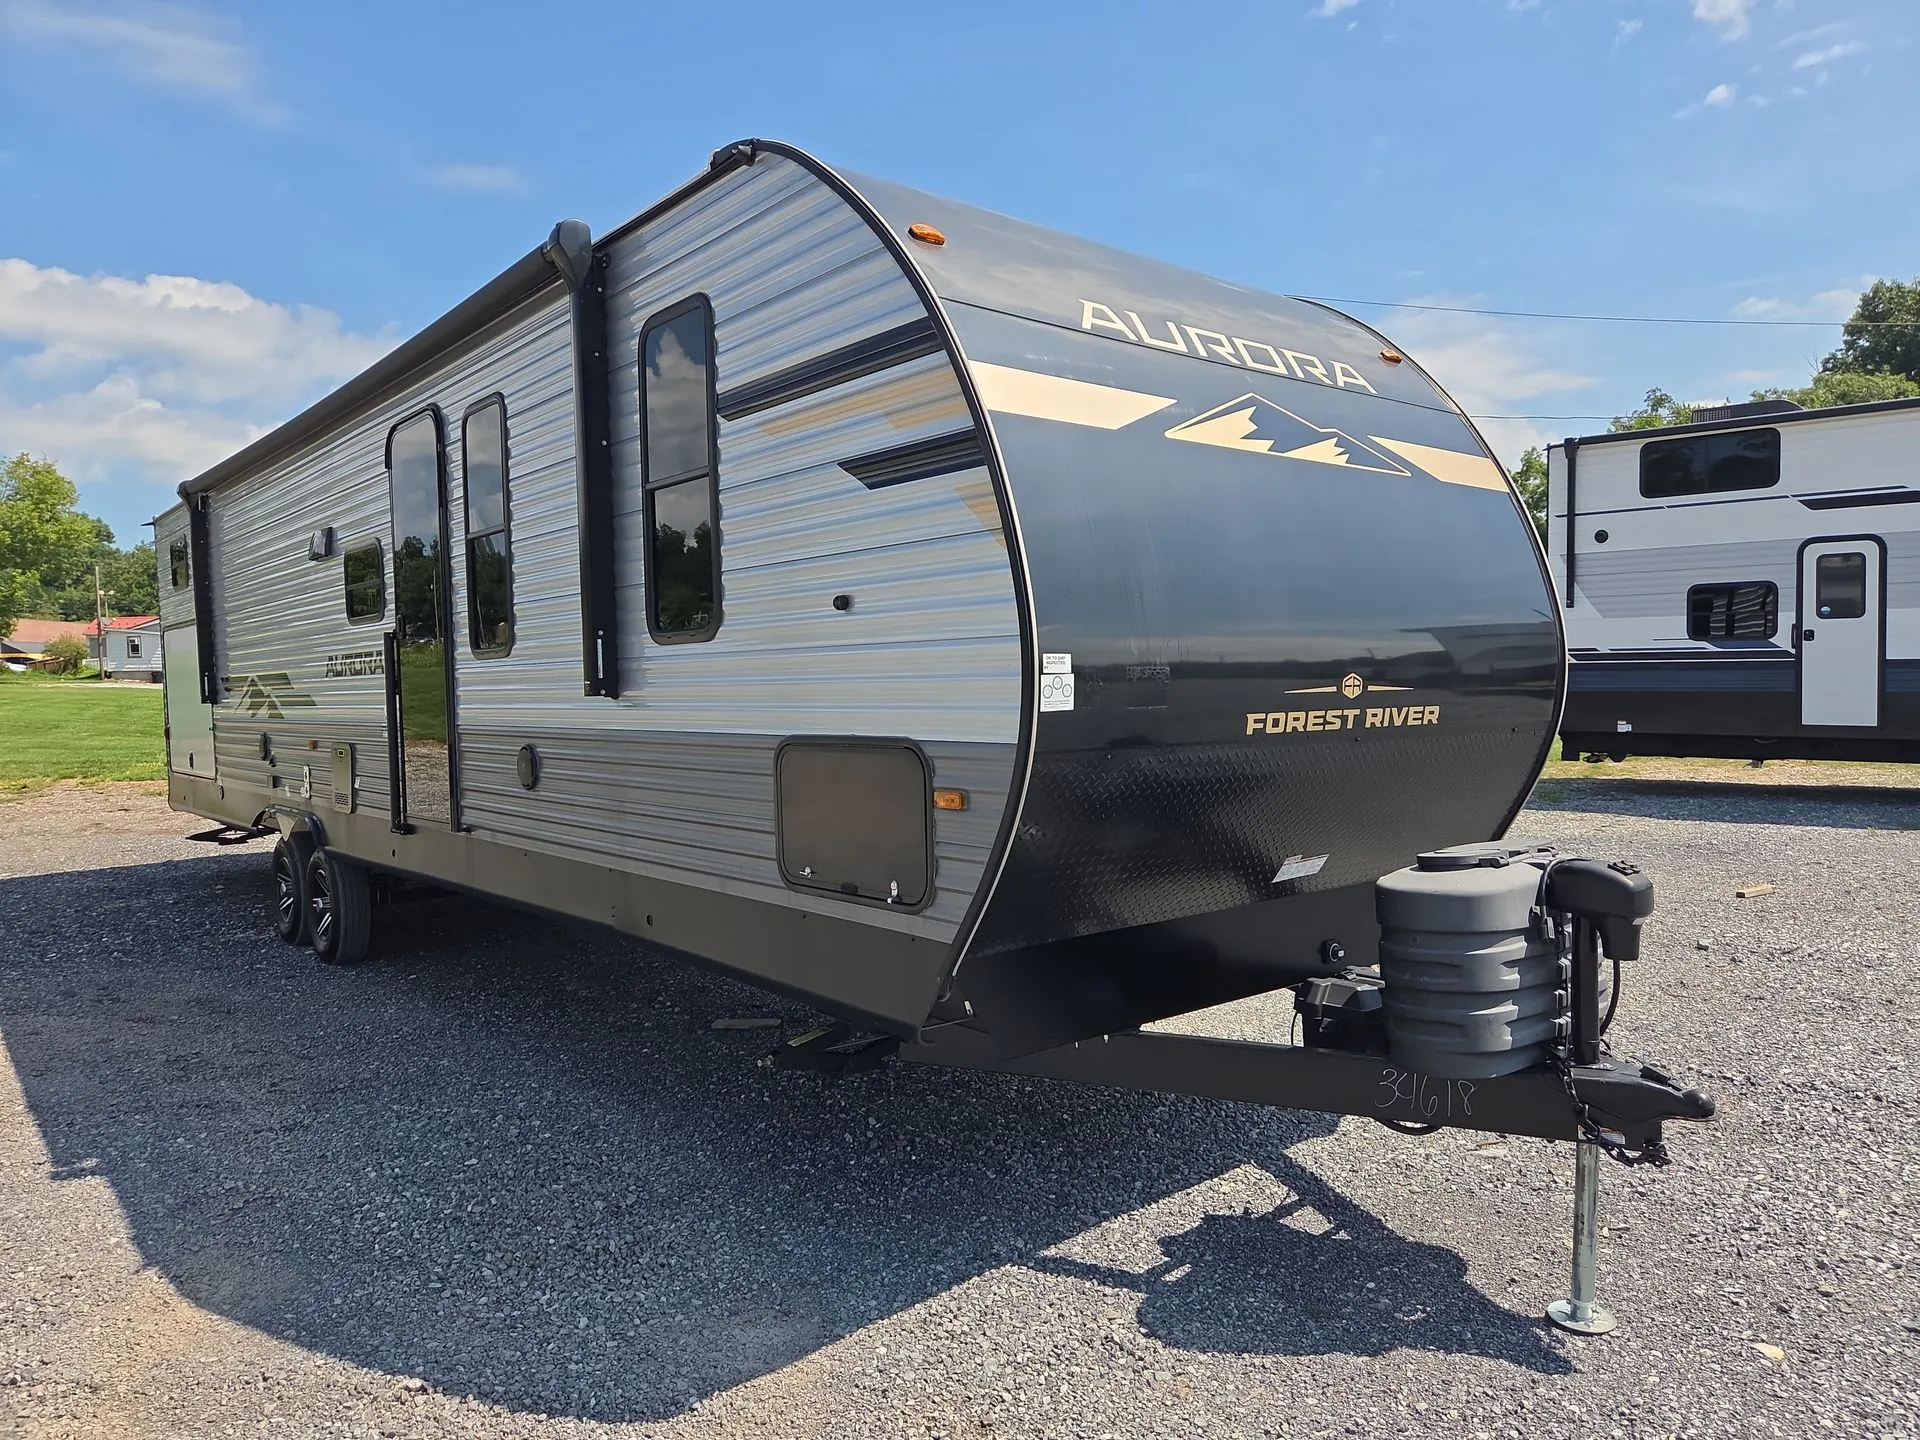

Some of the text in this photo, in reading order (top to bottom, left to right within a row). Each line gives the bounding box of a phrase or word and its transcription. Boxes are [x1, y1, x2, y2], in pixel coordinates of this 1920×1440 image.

[1079, 298, 1377, 394] AURORA
[325, 649, 384, 678] AURORA
[1246, 706, 1440, 735] FOREST RIVER
